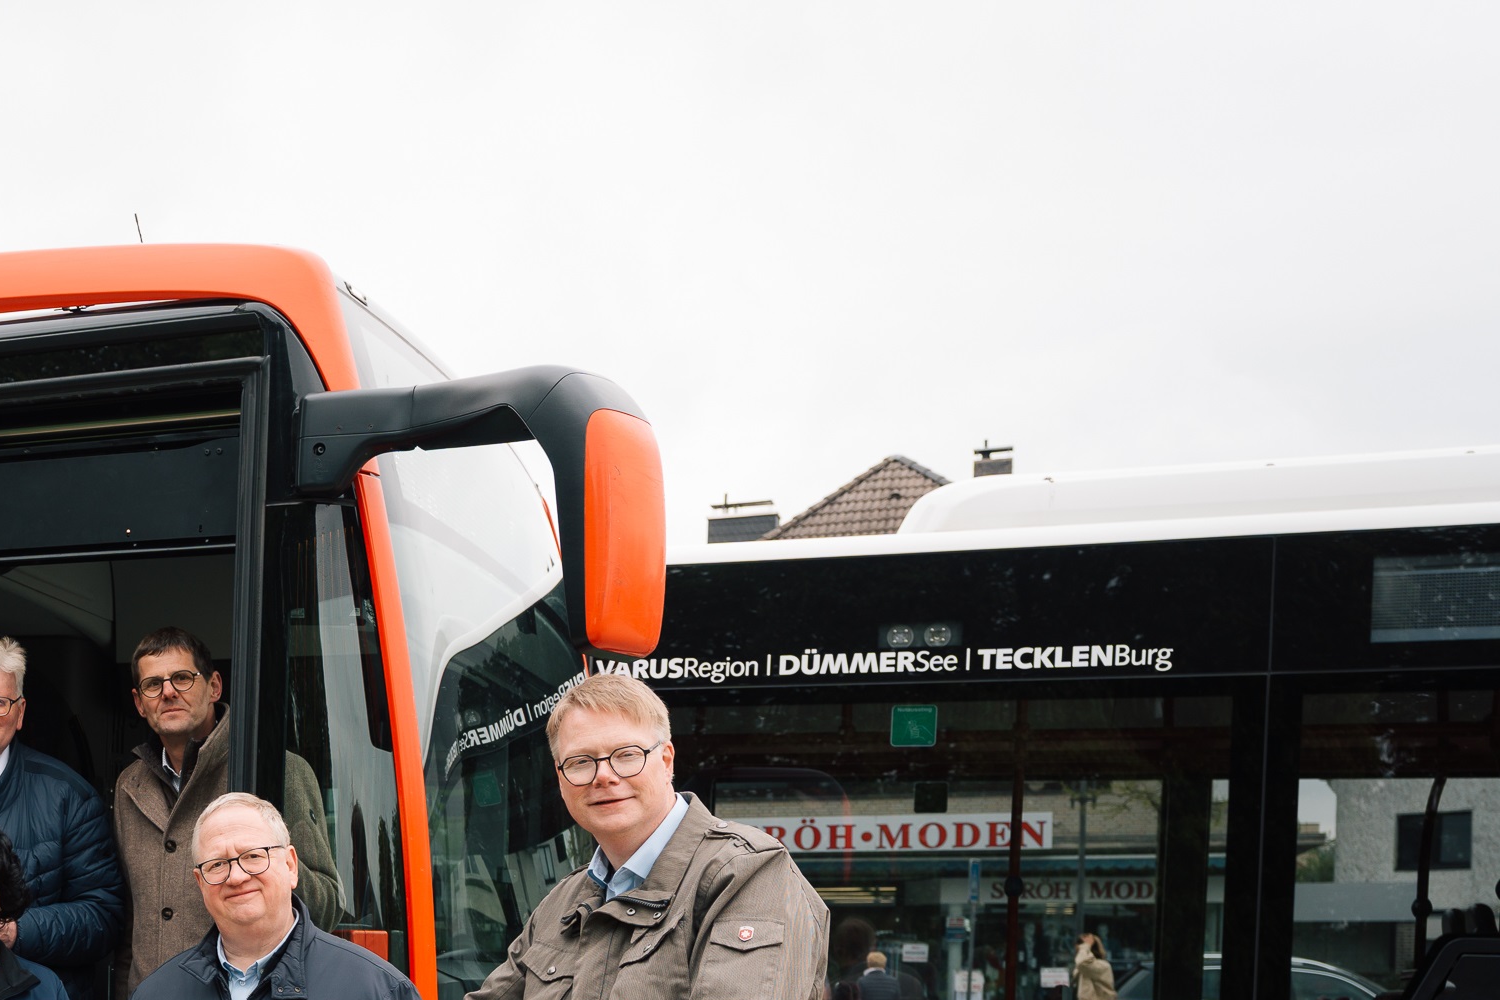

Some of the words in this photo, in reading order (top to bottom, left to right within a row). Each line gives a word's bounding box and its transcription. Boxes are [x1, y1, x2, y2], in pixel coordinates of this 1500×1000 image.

[596, 657, 759, 683] VARUSRegion
[778, 648, 958, 676] DÜMMERSee
[977, 643, 1174, 672] TECKLENBurg
[990, 877, 1071, 900] SRÖH
[1089, 880, 1154, 900] MOD
